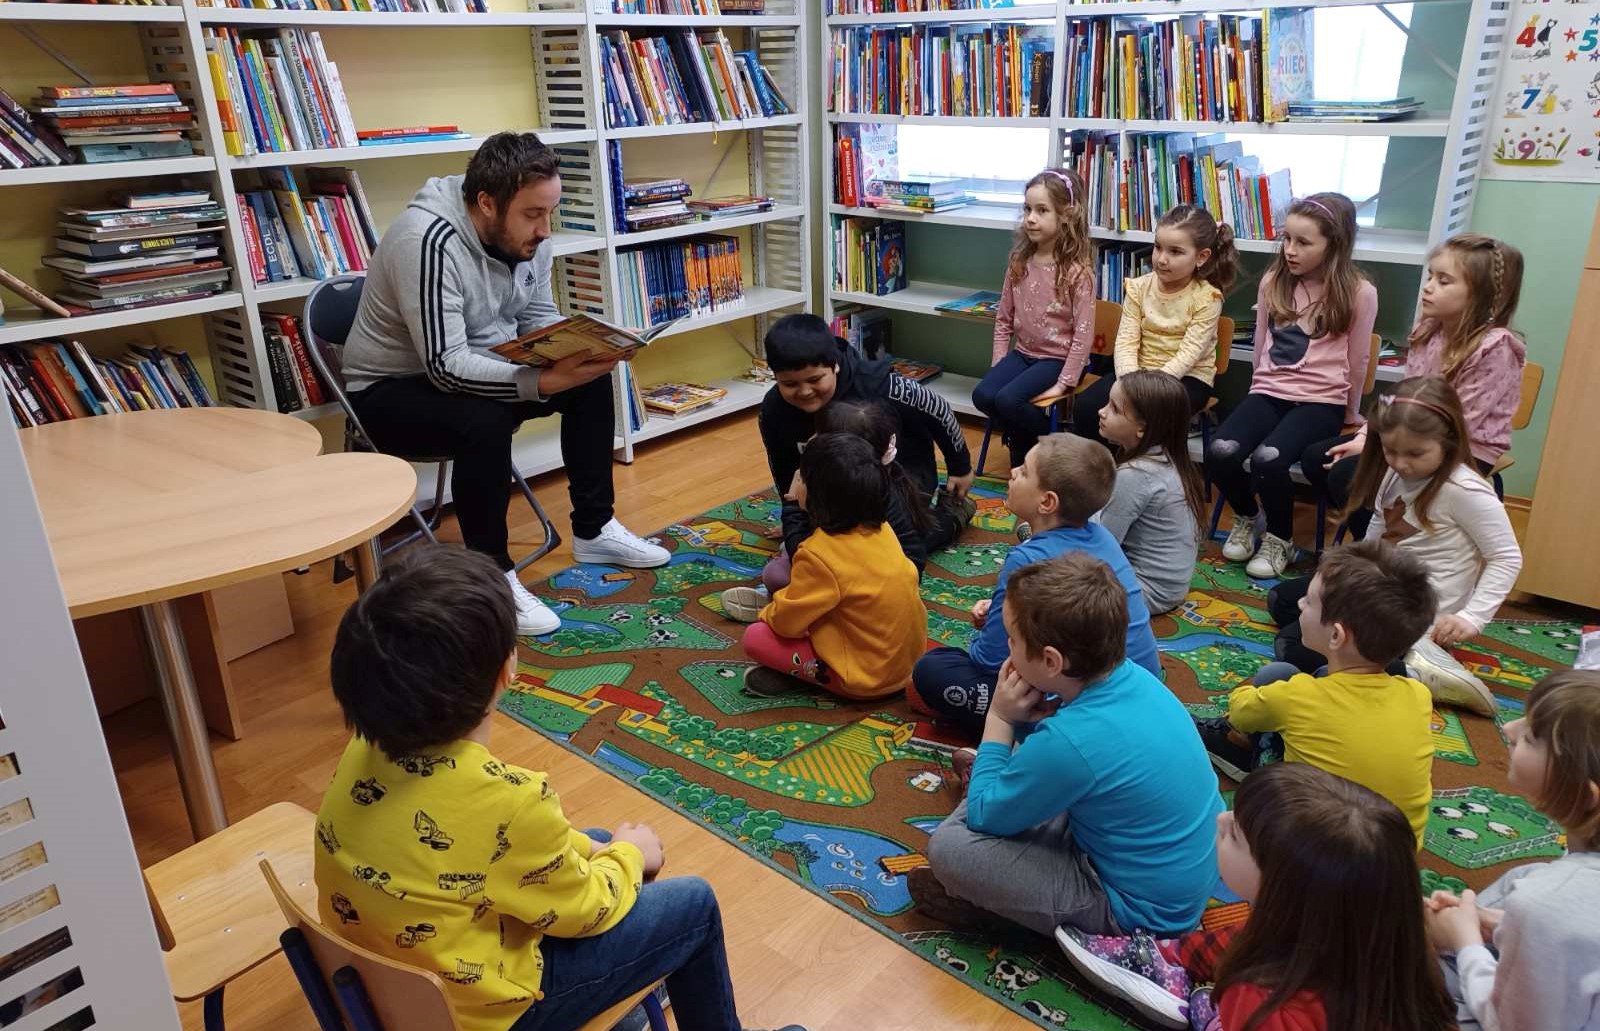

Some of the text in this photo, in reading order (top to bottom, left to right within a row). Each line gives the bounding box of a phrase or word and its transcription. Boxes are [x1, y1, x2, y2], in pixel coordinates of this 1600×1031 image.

[1516, 26, 1536, 48] 4
[1578, 29, 1599, 52] 5
[296, 59, 309, 89] RECORDS
[1521, 88, 1541, 110] 7
[1517, 139, 1536, 160] 9
[263, 229, 278, 263] ECDL
[974, 683, 989, 716] SPORT
